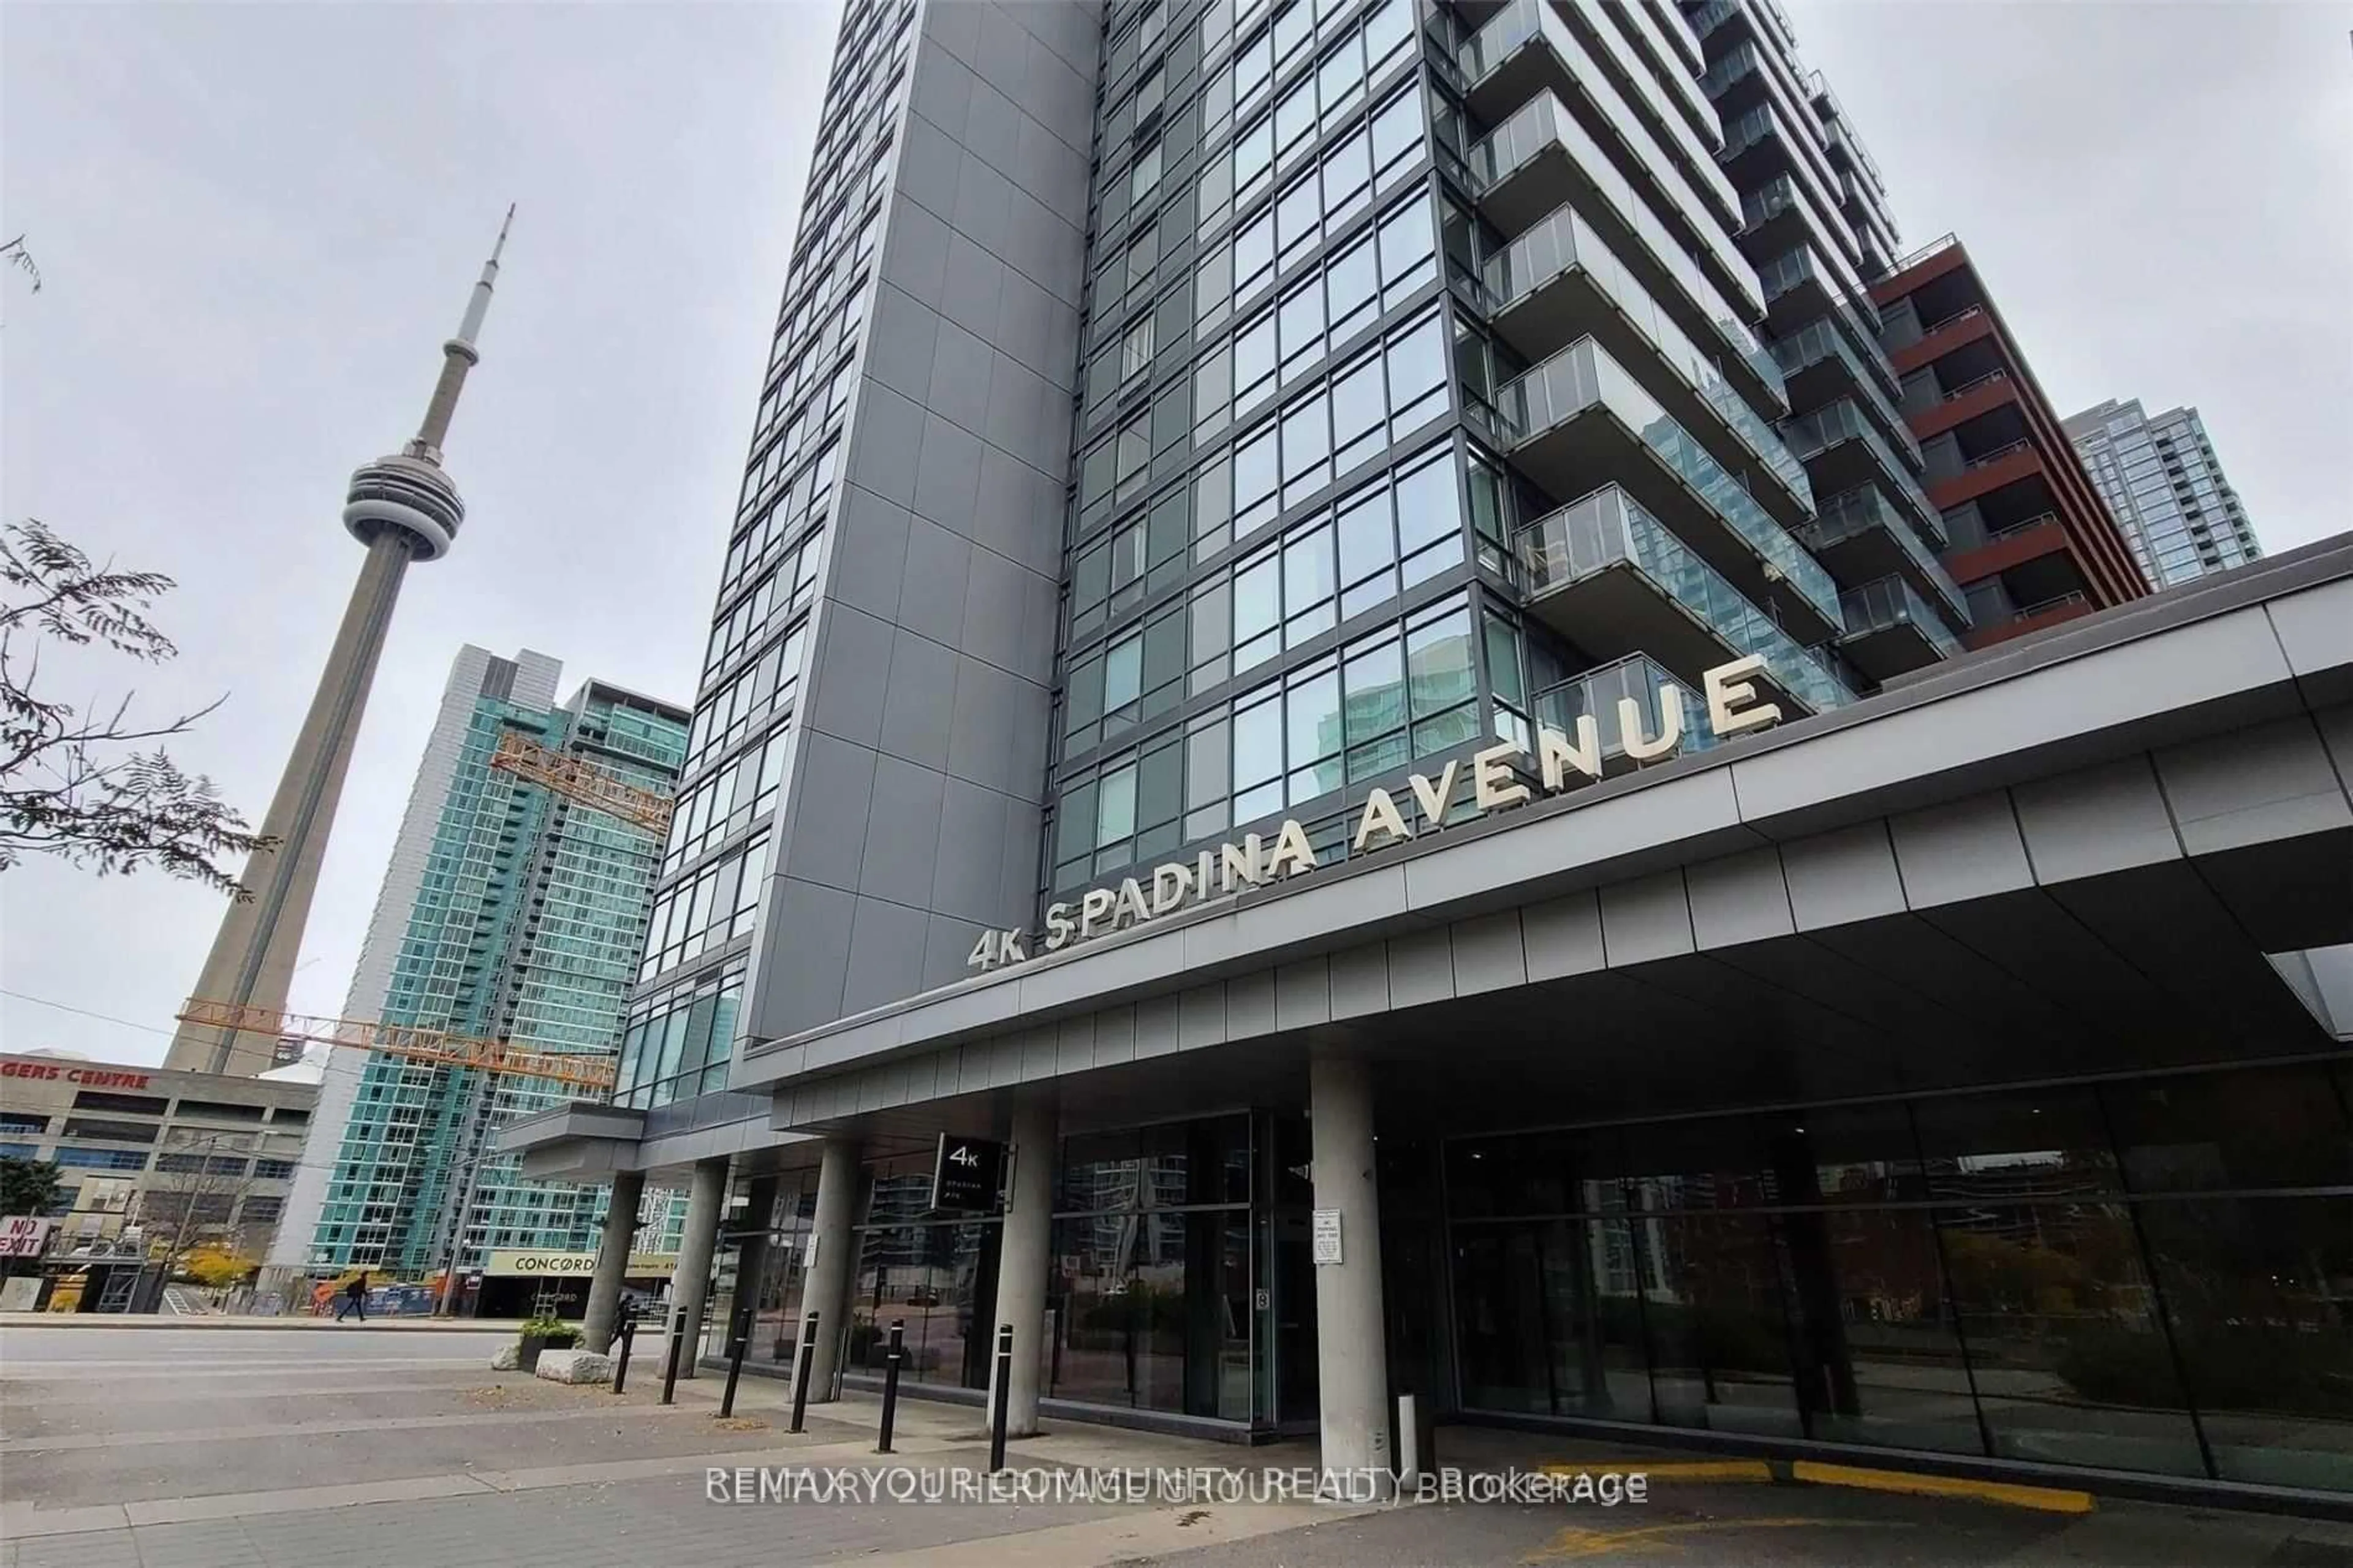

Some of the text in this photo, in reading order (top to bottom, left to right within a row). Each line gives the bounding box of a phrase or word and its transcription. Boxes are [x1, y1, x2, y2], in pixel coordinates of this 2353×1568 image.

[968, 652, 1783, 971] 4K SPADINA AVENUE
[67, 1069, 149, 1089] CENTRE
[949, 1145, 978, 1167] 4K
[10, 1219, 38, 1235] NO
[0, 1238, 39, 1252] EXIT
